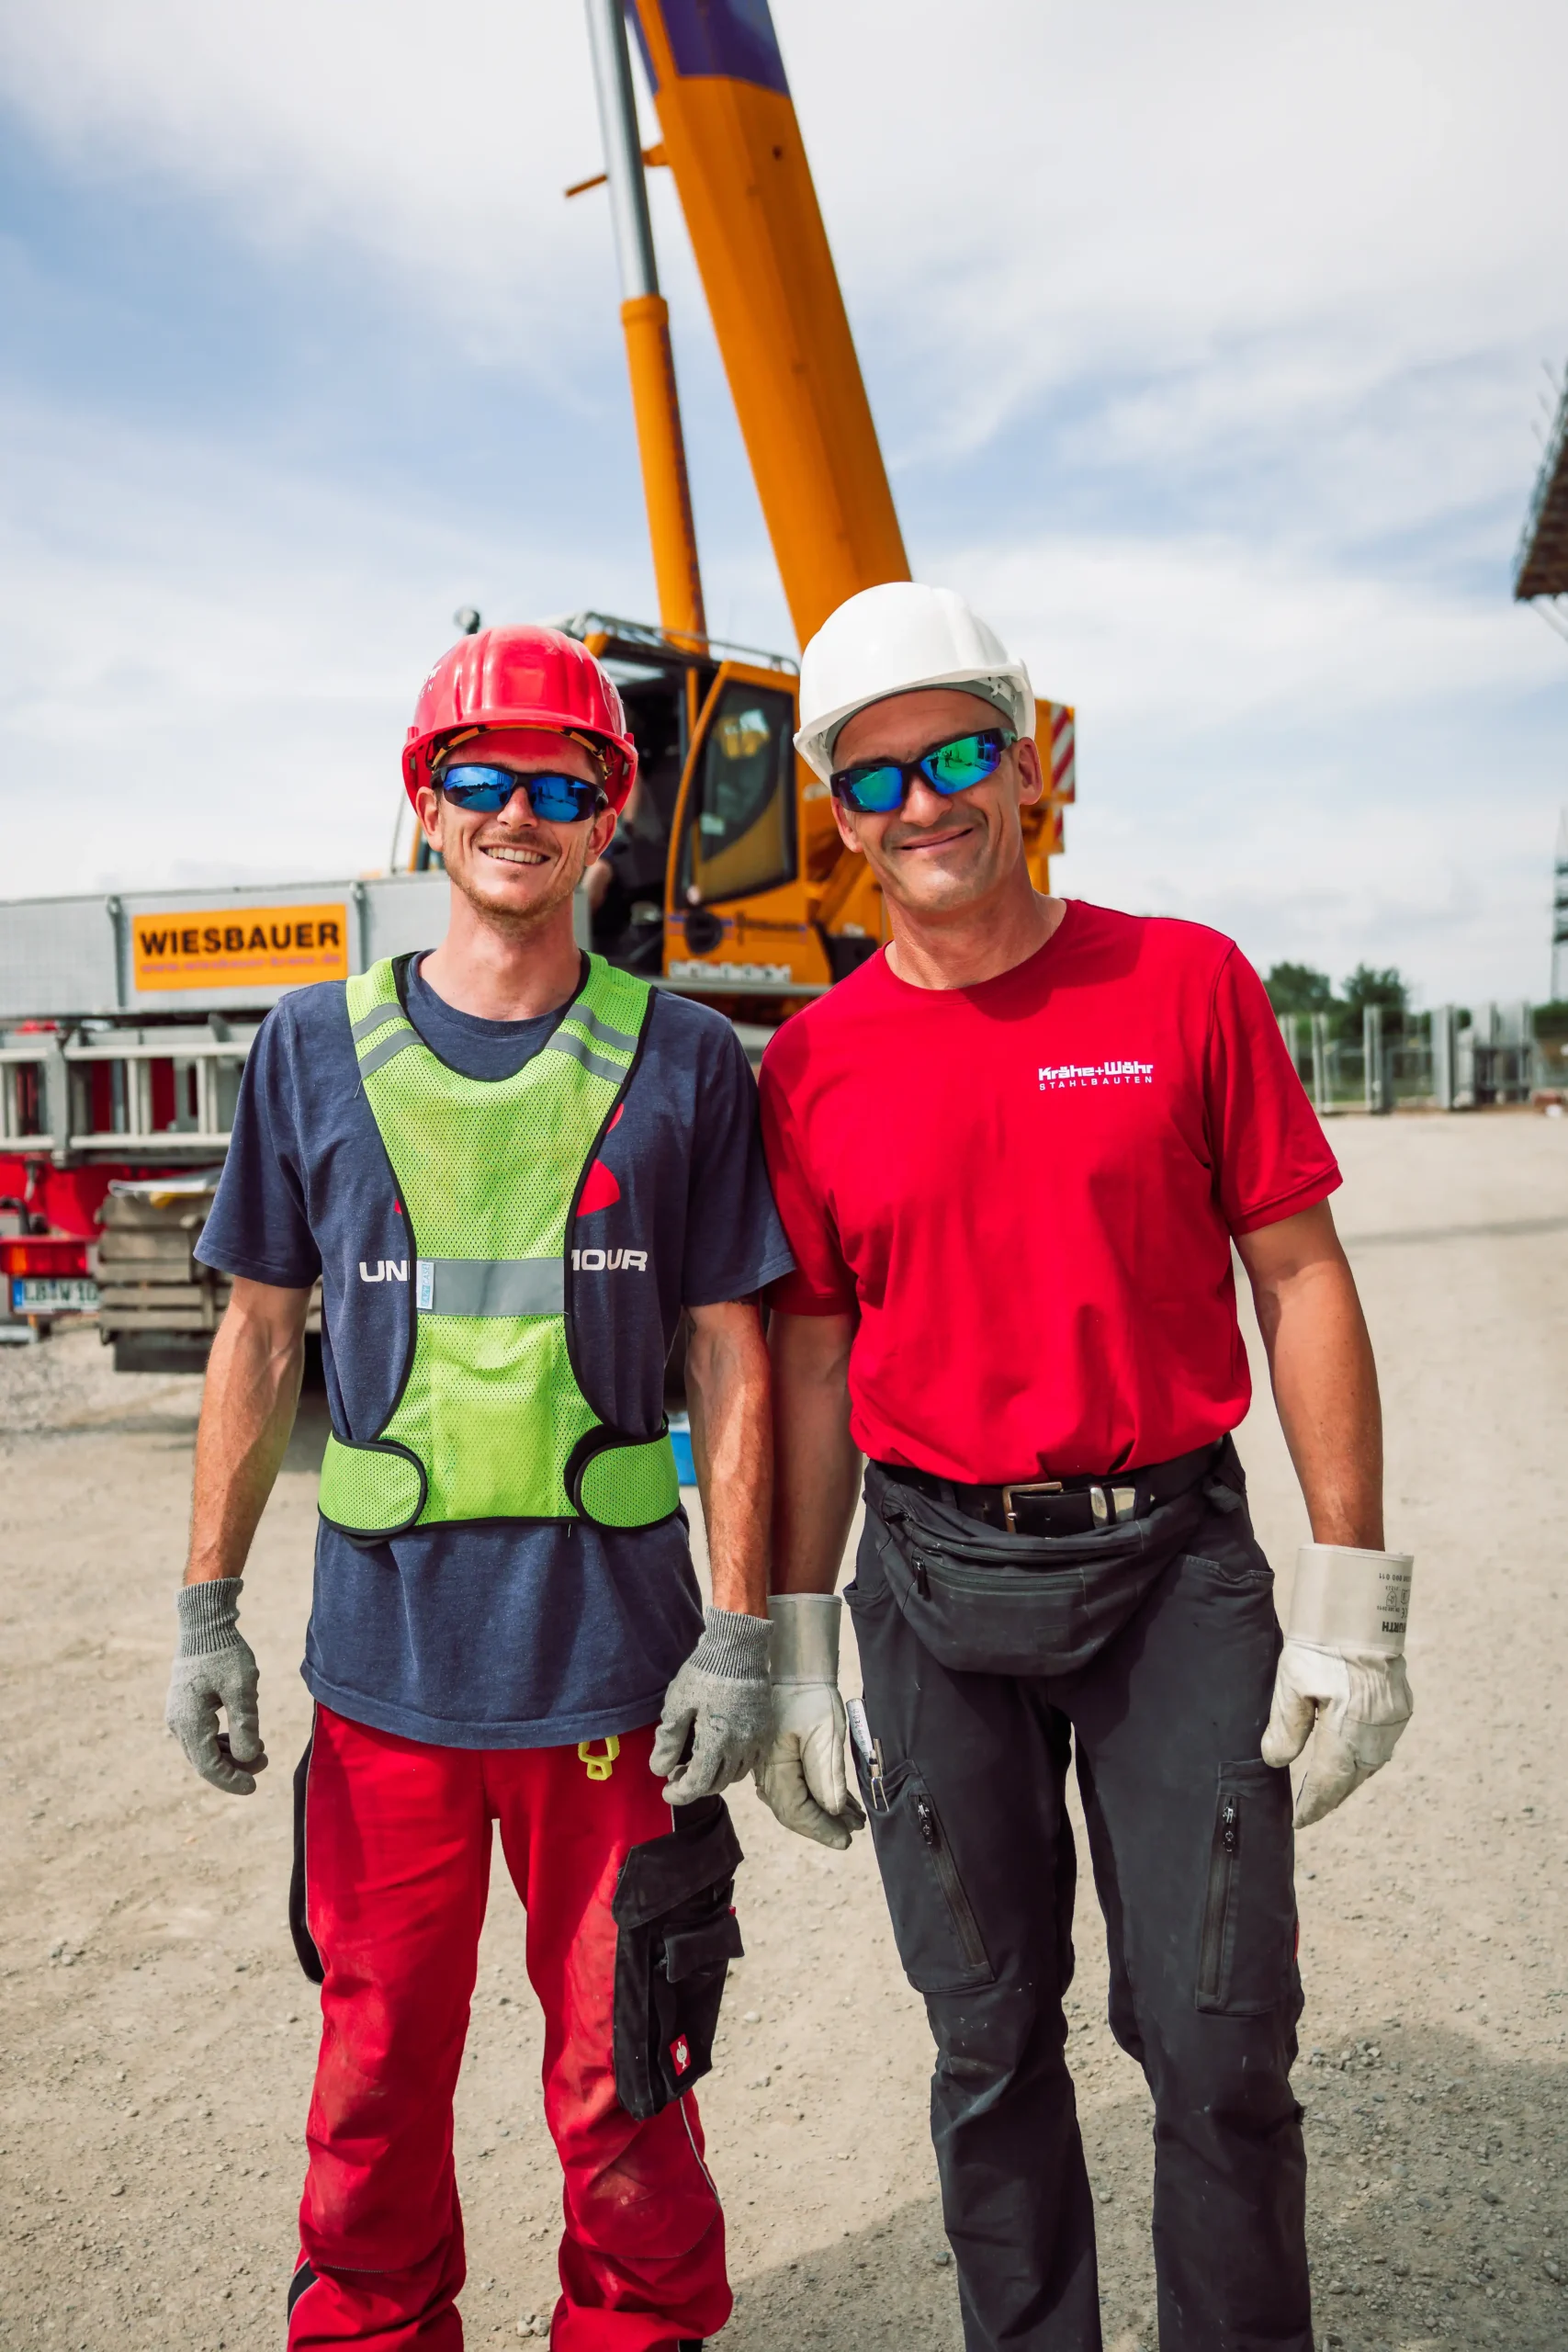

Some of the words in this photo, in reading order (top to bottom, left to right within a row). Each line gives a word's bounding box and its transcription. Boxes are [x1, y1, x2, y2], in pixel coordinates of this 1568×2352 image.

[141, 922, 339, 956] WIESBAUER
[1038, 1060, 1154, 1081] Krähe+Wöhr
[1039, 1076, 1153, 1091] STAHLBAUTEN
[359, 1260, 411, 1283] UN
